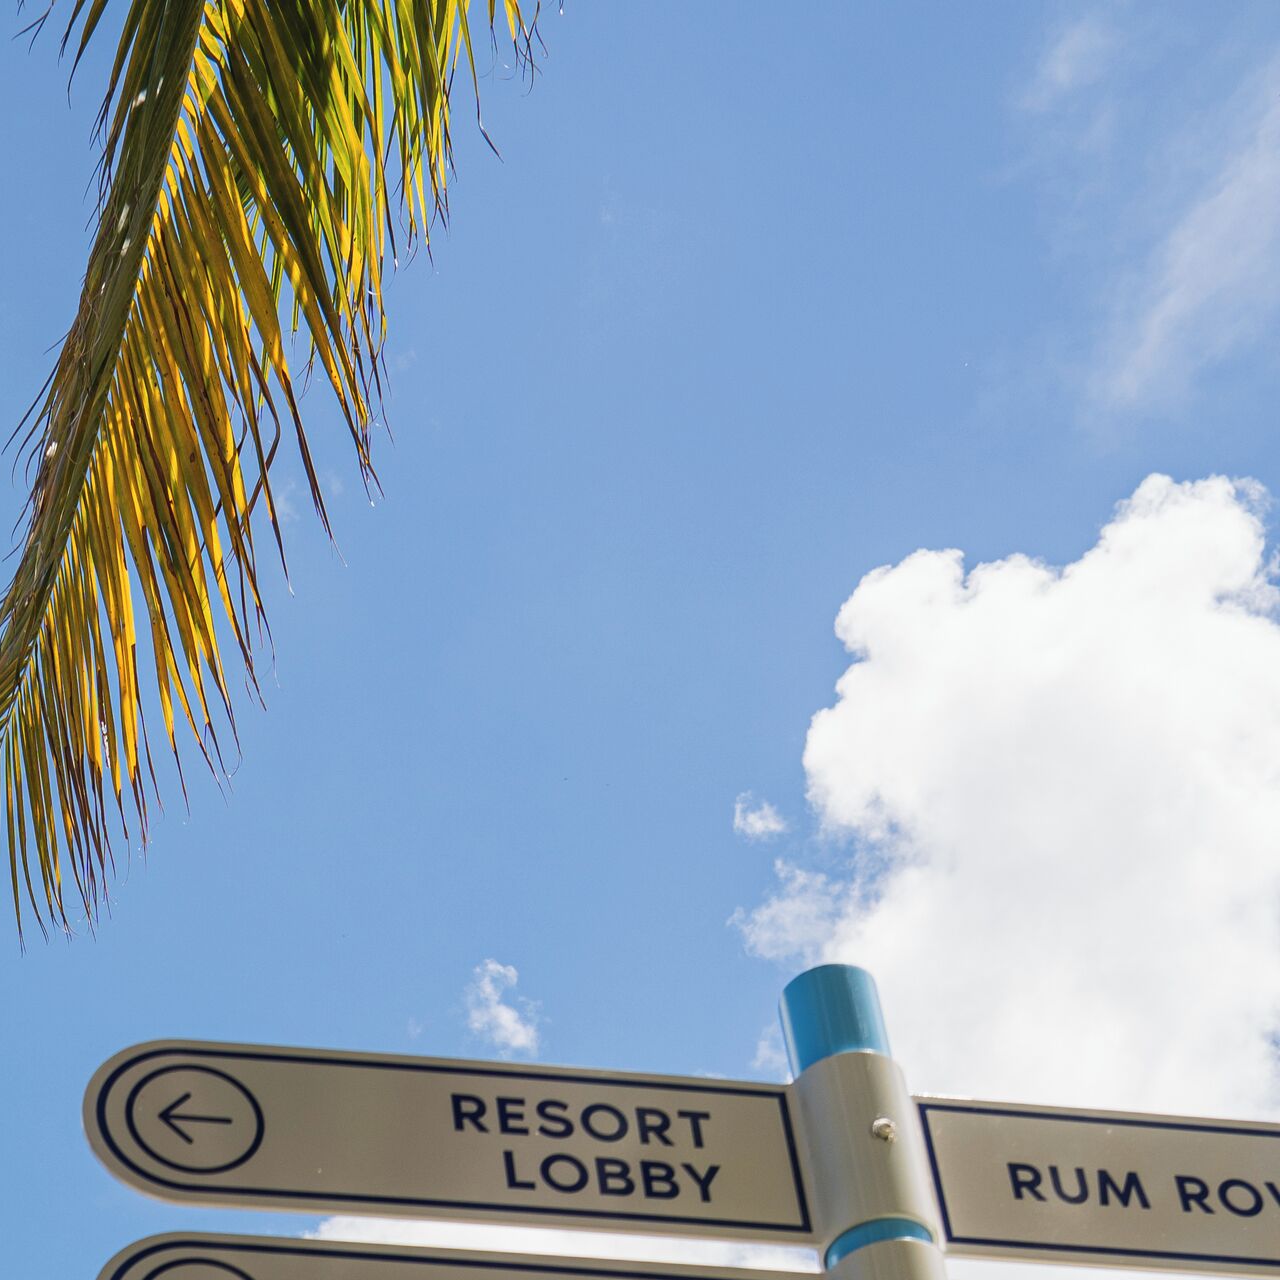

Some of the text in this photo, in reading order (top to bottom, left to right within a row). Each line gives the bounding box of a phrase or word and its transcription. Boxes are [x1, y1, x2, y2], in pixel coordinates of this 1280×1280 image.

[449, 1092, 712, 1150] RESORT
[502, 1149, 721, 1204] LOBBY
[1006, 1162, 1280, 1218] RUM RO
